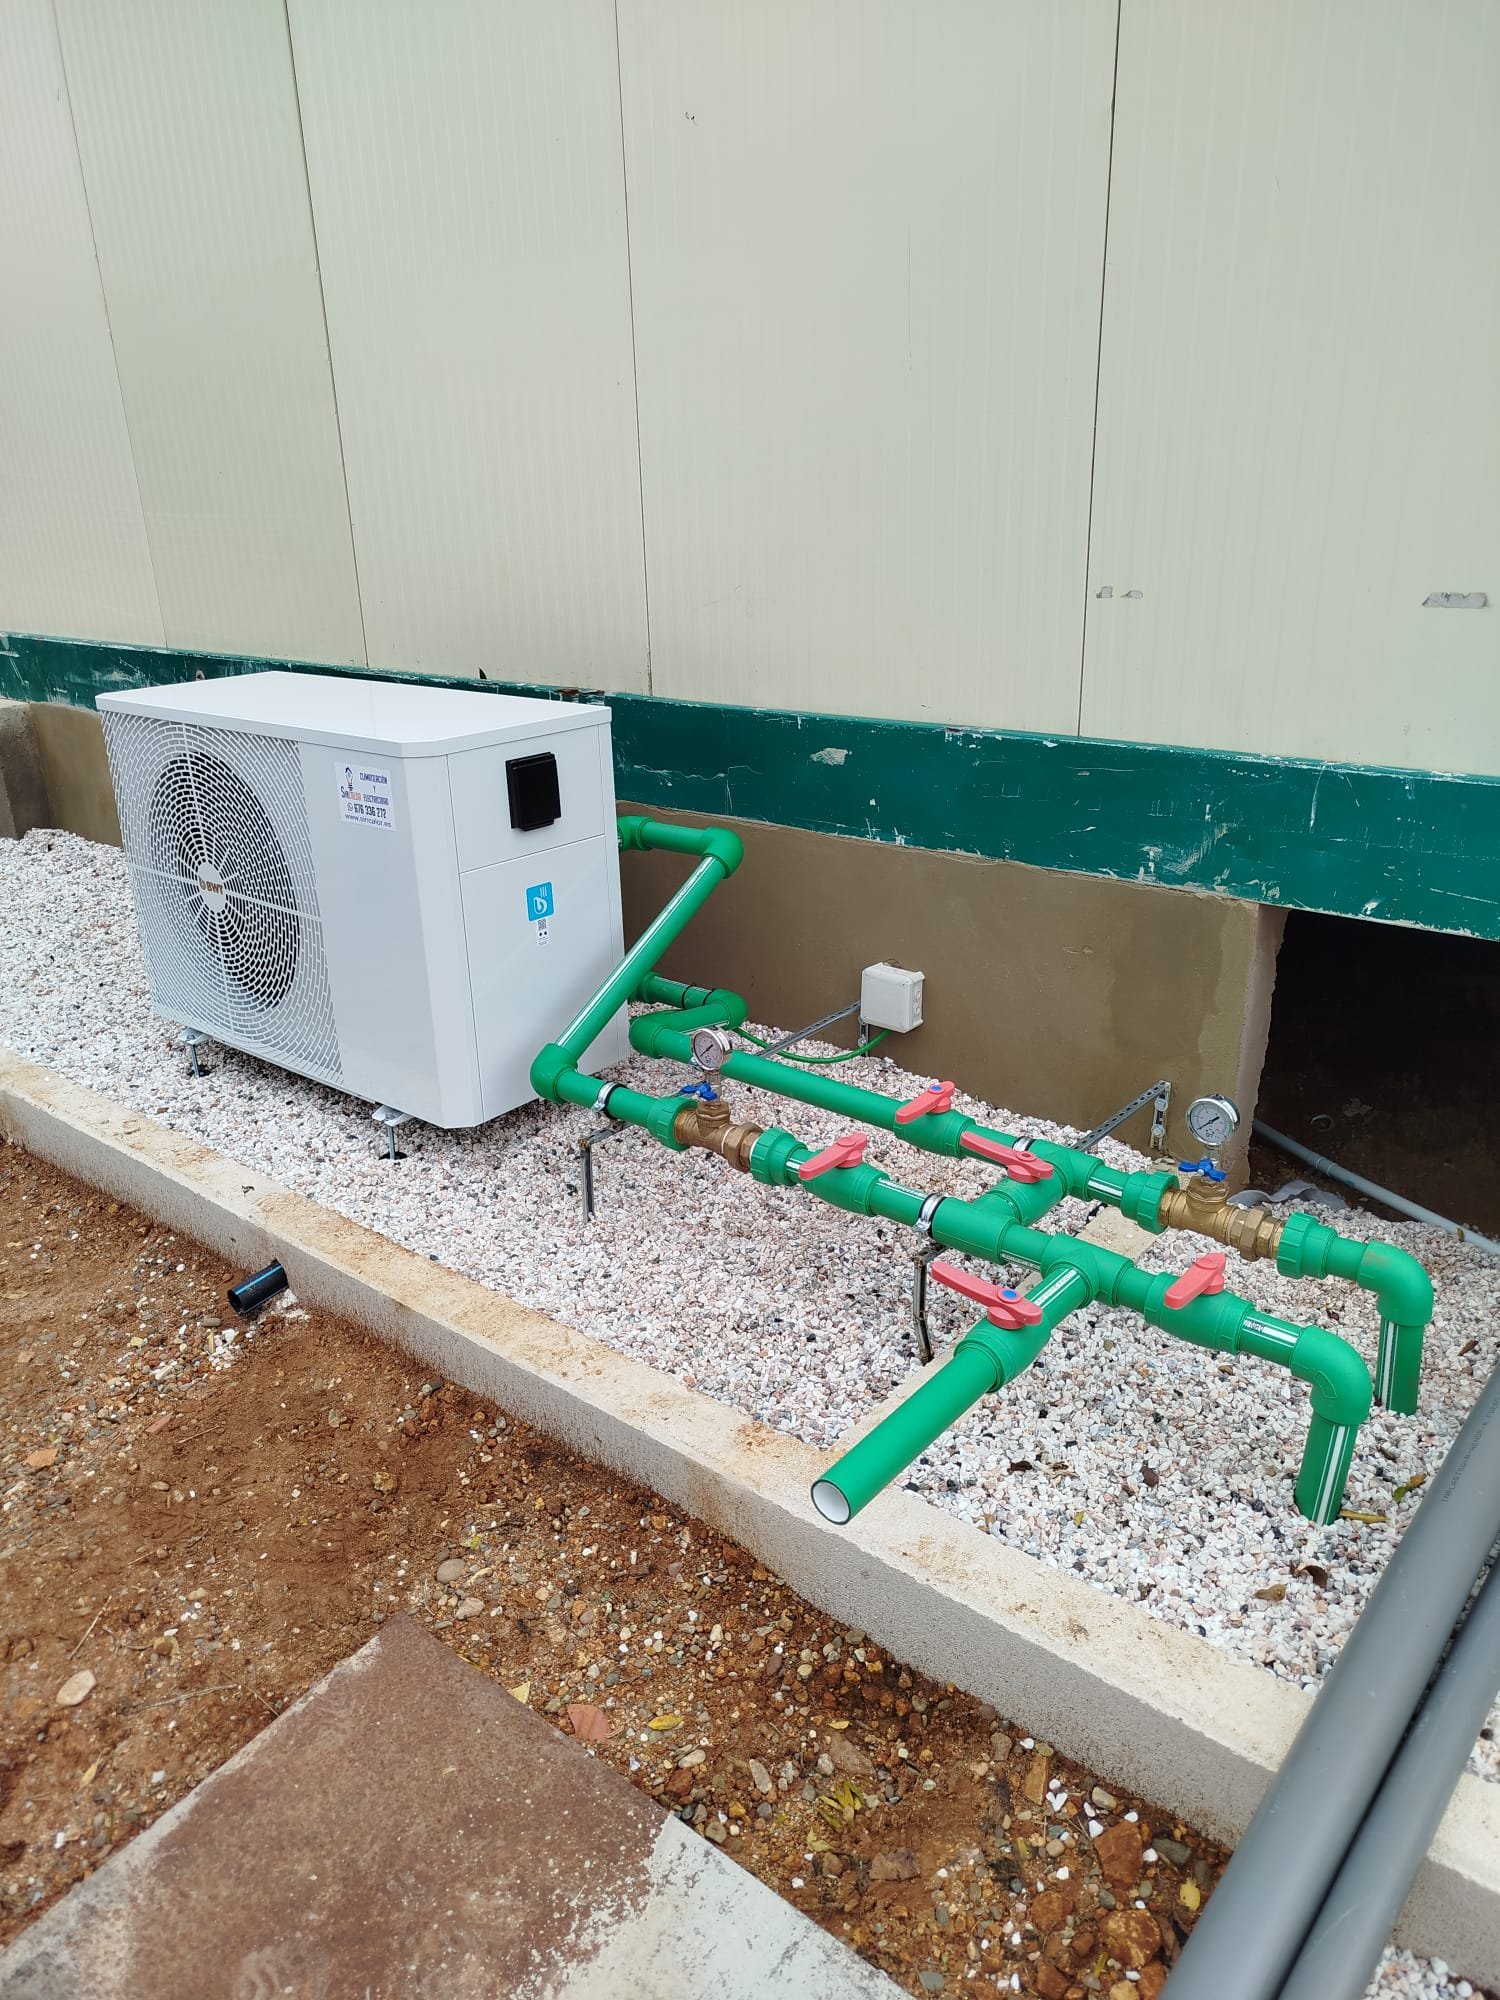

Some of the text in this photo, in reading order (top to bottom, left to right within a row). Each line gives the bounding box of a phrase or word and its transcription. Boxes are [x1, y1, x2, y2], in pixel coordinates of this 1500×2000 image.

[344, 813, 392, 828] www.sincalor.es
[376, 807, 387, 819] 272
[206, 880, 224, 895] BWT
